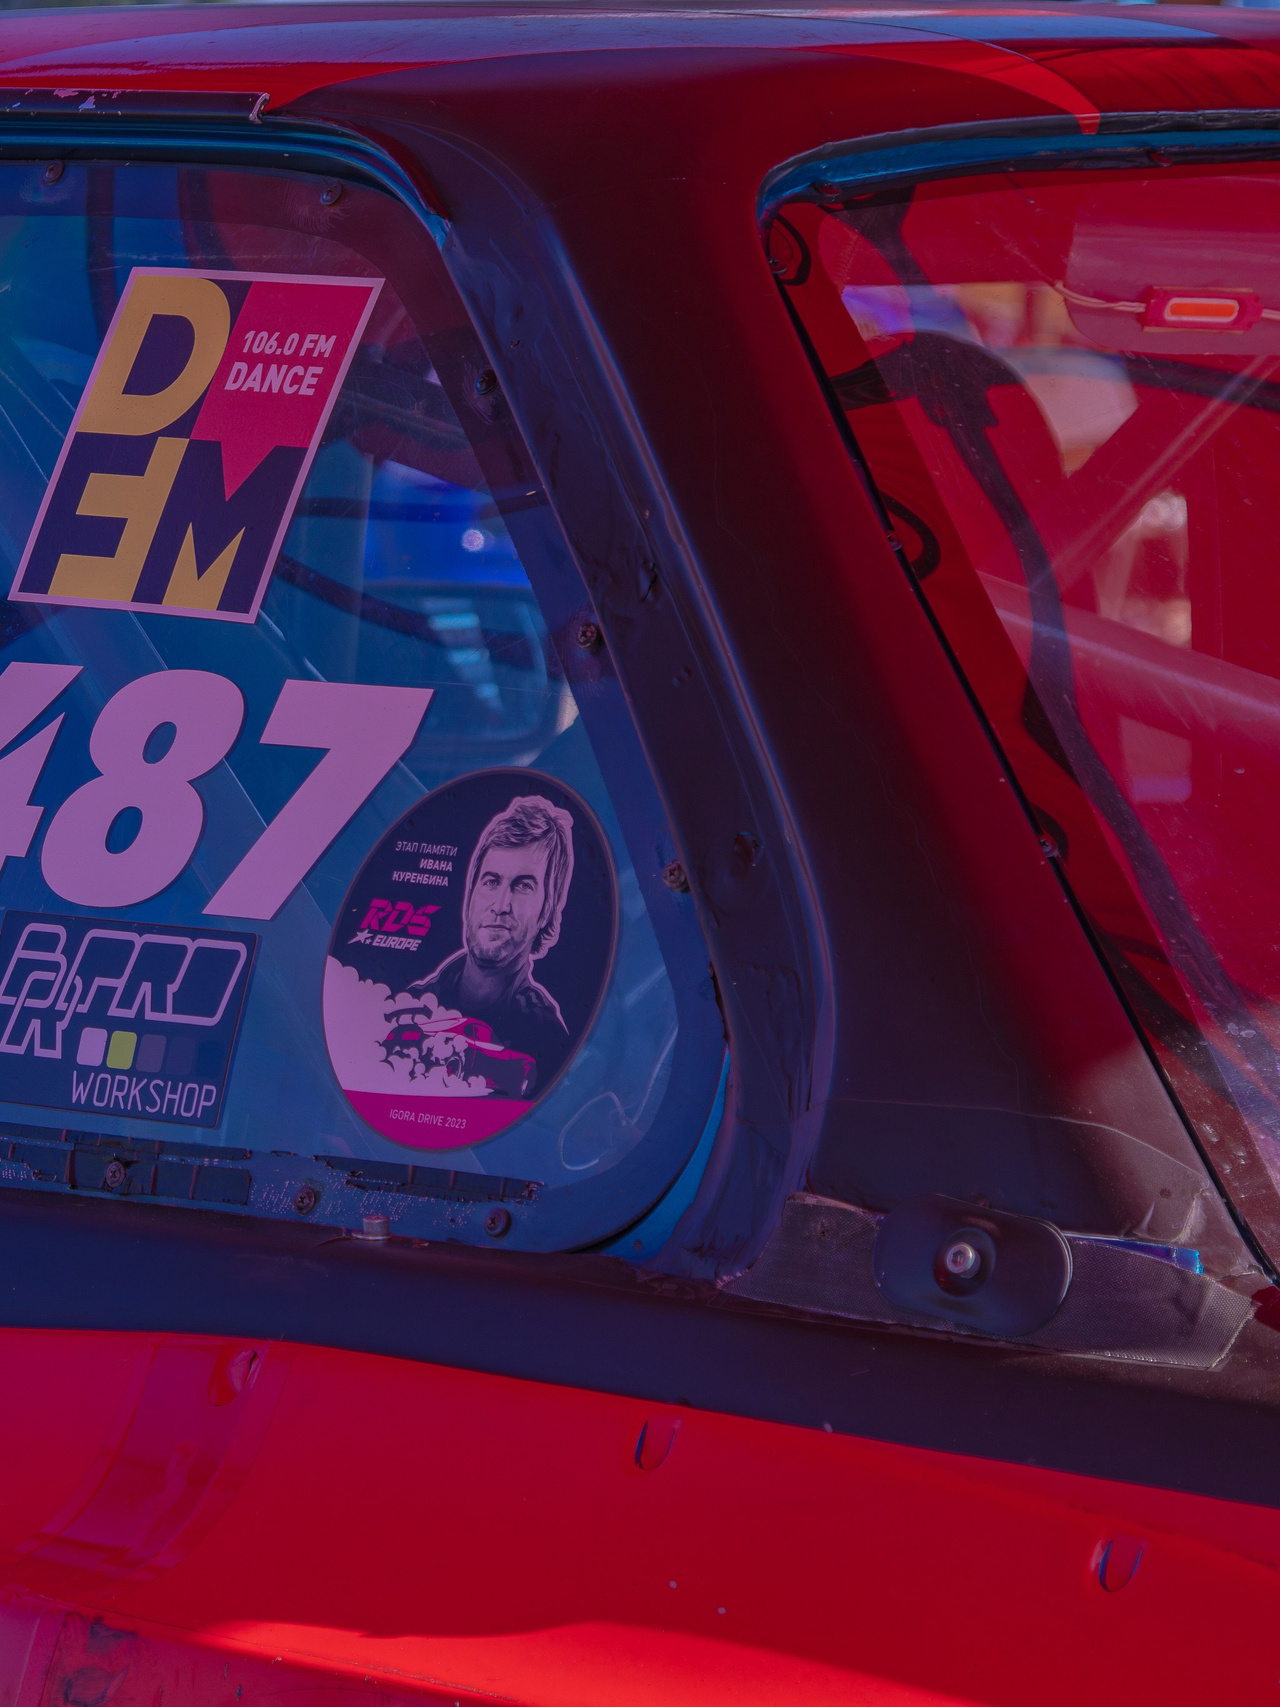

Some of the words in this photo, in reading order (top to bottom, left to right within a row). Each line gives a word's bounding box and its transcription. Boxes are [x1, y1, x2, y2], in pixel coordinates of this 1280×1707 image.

[242, 330, 300, 356] 106.0
[299, 333, 337, 358] FM
[224, 361, 324, 396] DANCE
[395, 841, 419, 853] ЭТАП
[419, 843, 458, 857] ПАМЯТИ
[419, 858, 453, 872] ИВАНА
[392, 871, 449, 887] КУРЕНБИНА
[360, 898, 442, 936] RDS
[372, 934, 422, 951] EUROPE
[71, 1070, 217, 1118] WORKSHOP
[389, 1108, 416, 1122] IGORA
[417, 1112, 444, 1127] DRIVE
[445, 1117, 467, 1130] 2023
